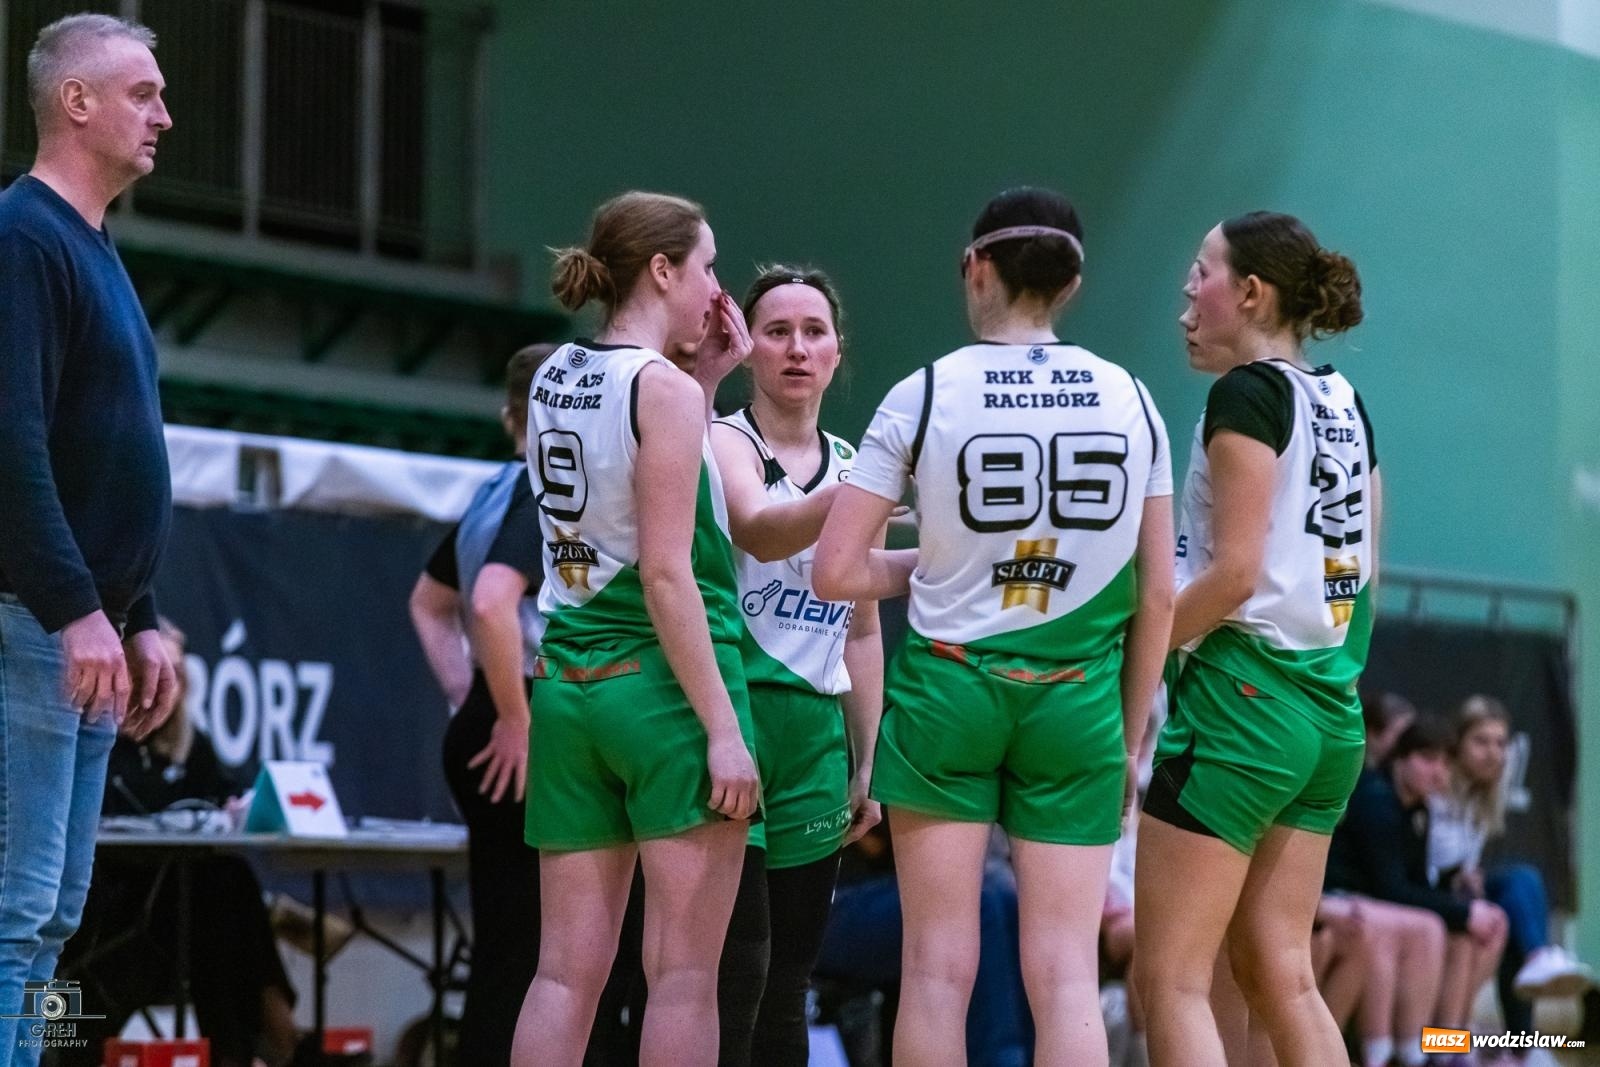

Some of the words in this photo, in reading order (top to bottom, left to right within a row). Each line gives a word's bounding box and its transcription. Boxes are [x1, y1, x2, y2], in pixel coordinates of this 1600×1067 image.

[984, 370, 1034, 384] RKK
[1051, 370, 1094, 384] AZS
[983, 388, 1101, 409] RACIBÓRZ
[536, 428, 588, 522] 9
[957, 431, 1129, 533] 85
[997, 560, 1069, 583] SEGET
